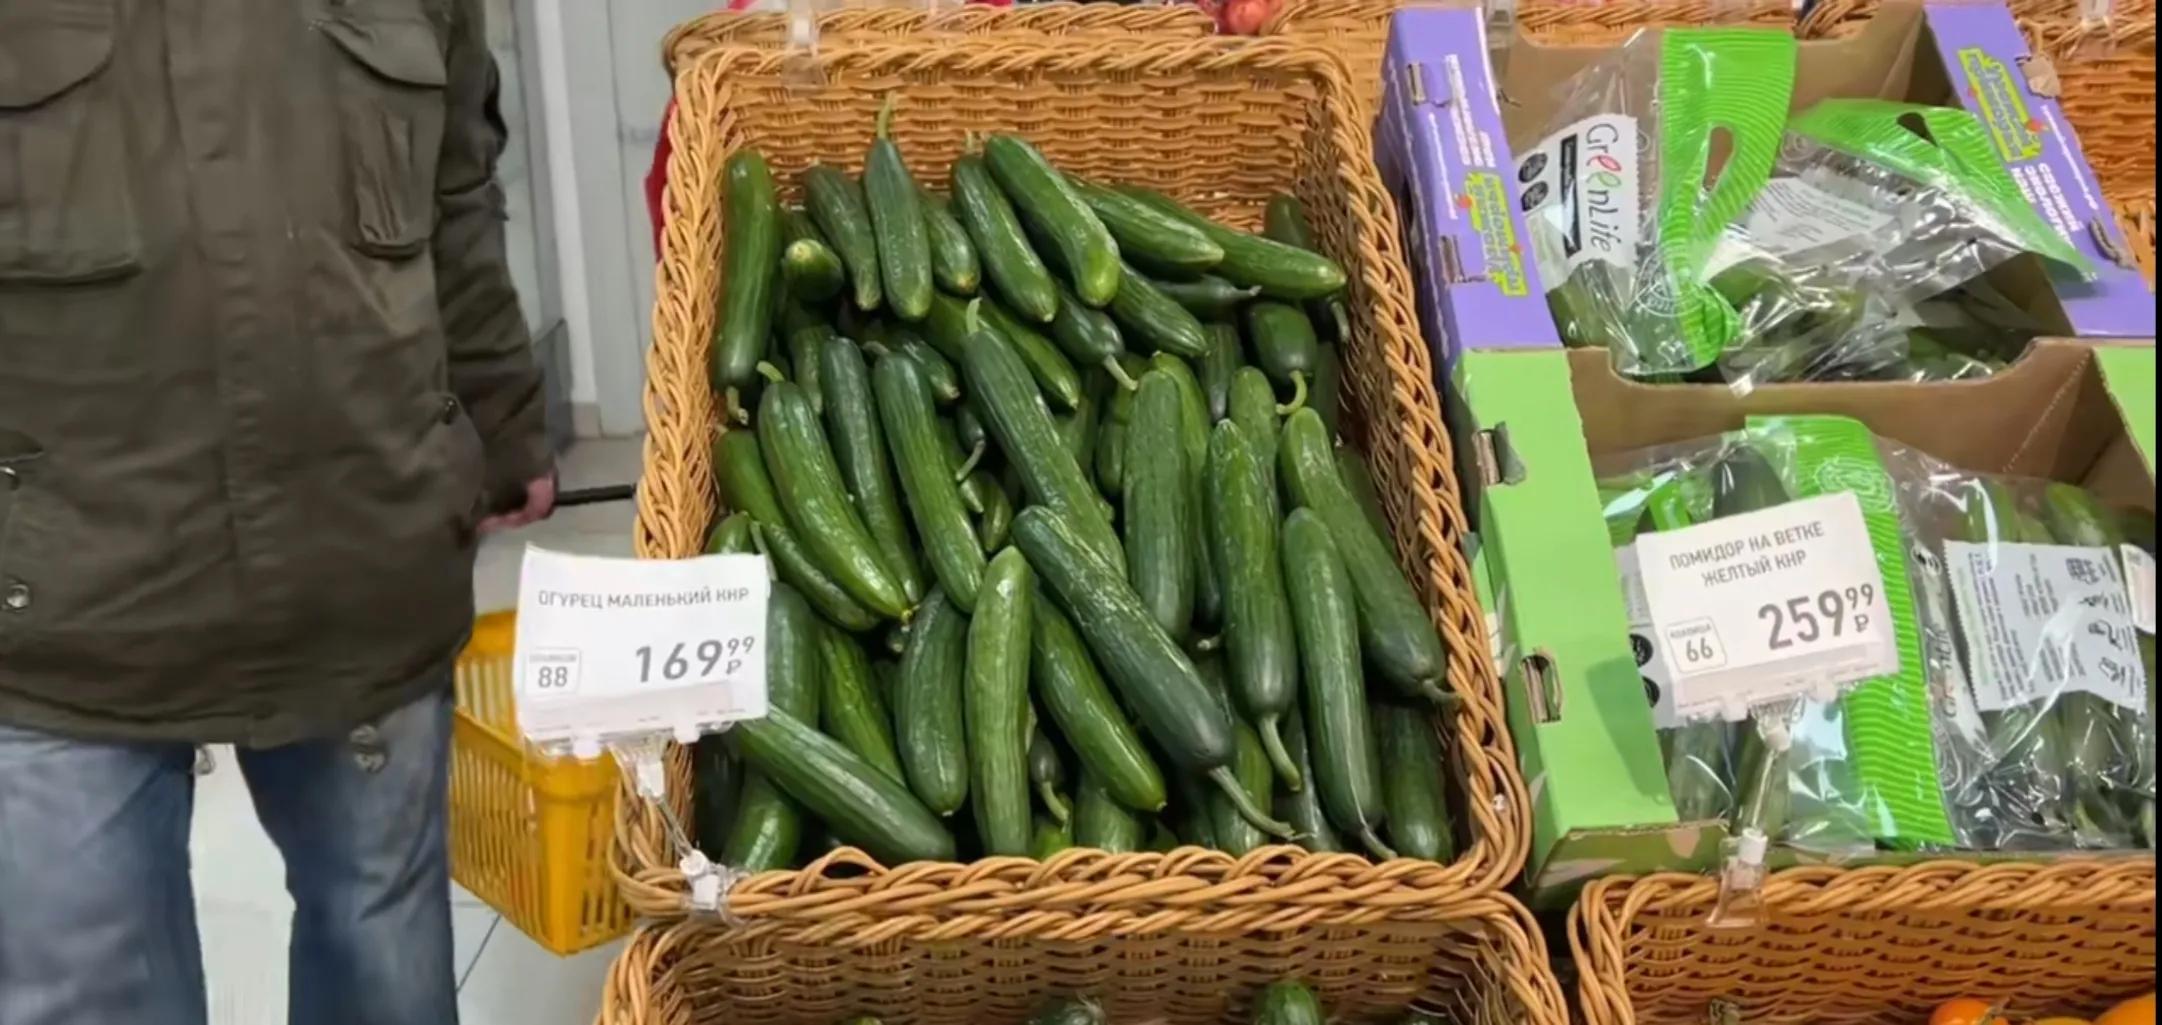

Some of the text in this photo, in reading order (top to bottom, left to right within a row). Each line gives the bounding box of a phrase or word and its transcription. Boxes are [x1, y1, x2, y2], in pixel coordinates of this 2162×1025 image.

[1586, 123, 1622, 252] GreenLife
[1669, 521, 1825, 571] ПОМИДОР НА ВЕТКЕ
[1702, 549, 1807, 587] ЖЕЛТЫЙ КНР
[538, 586, 749, 609] ОГУРЕЦ МАЛЕНЬКИЙ КНР
[1758, 583, 1873, 650] 259 99
[636, 636, 755, 683] 169 99
[1686, 637, 1714, 662] 66
[538, 666, 568, 688] 88
